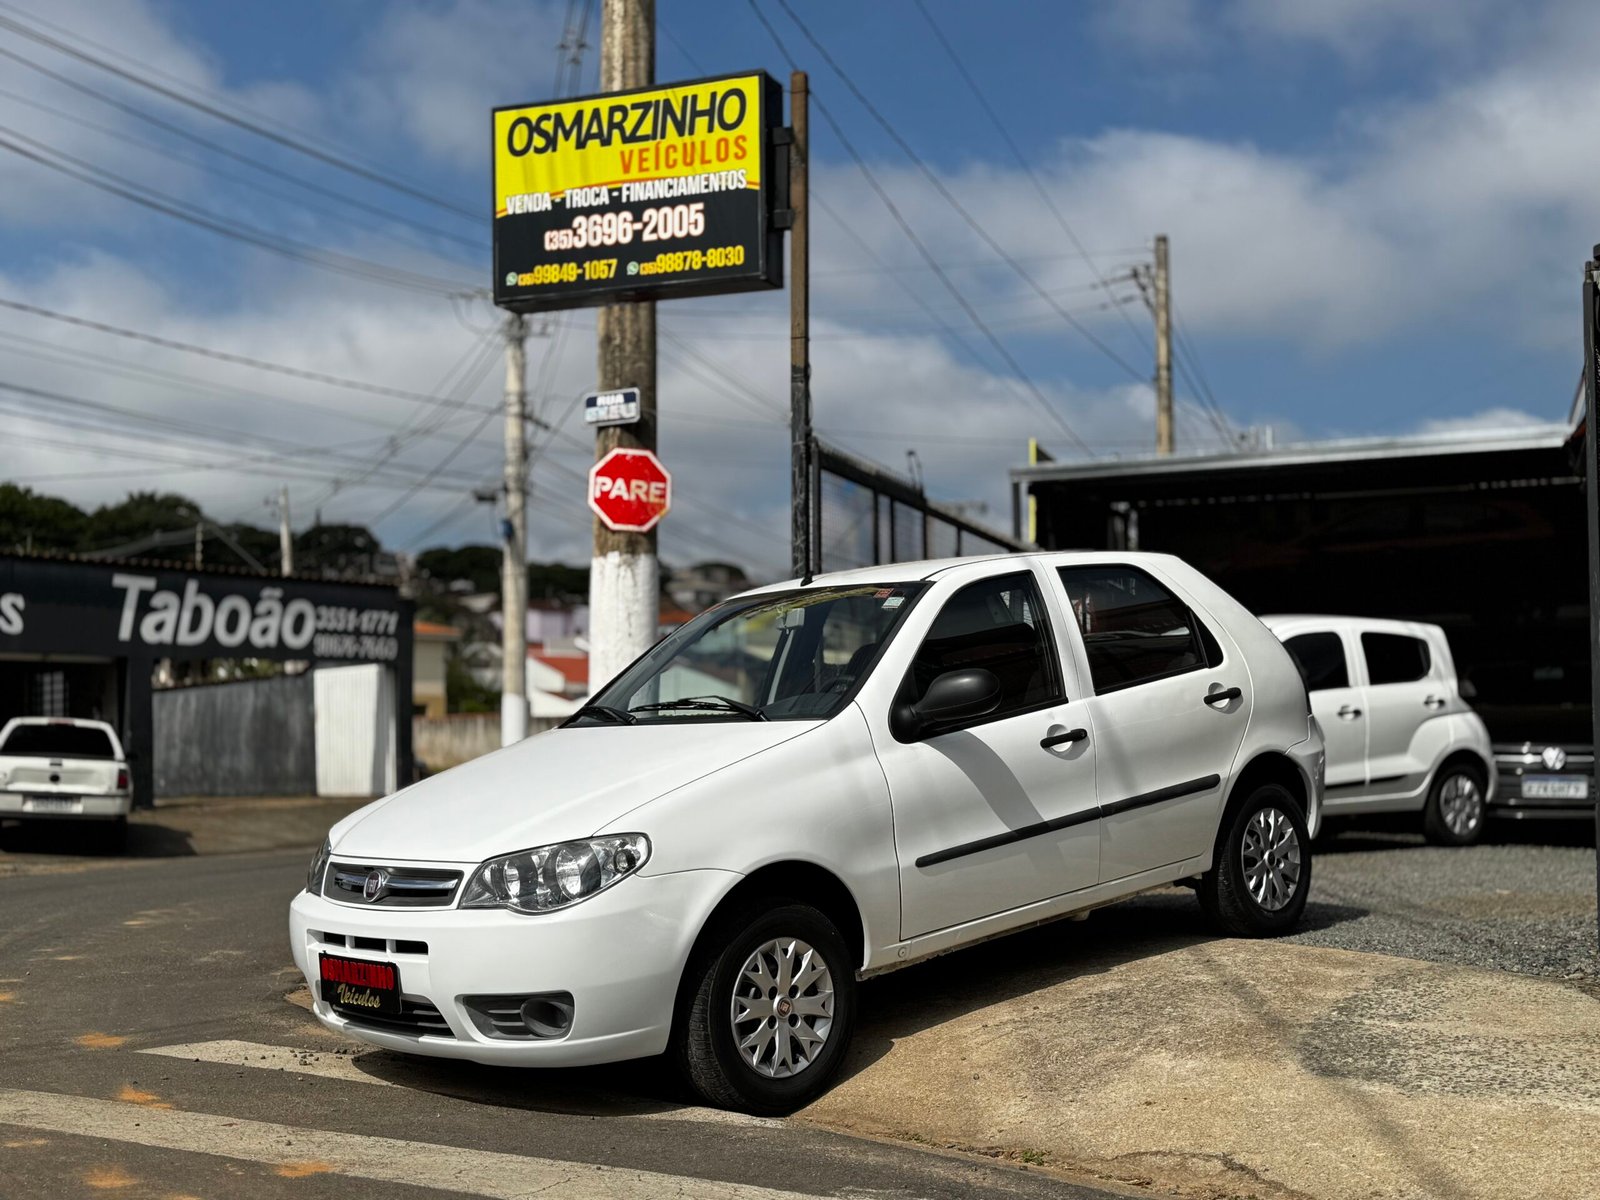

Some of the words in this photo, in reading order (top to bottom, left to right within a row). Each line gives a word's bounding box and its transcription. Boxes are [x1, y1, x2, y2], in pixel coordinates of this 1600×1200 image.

[507, 88, 747, 157] OSMARZINHO
[620, 134, 748, 175] VEÍCULOS
[505, 196, 552, 215] VENDA
[565, 186, 610, 209] TROCA
[621, 169, 748, 202] FINANCIAMENTOS
[594, 475, 666, 503] PARE
[111, 573, 316, 649] Taboão
